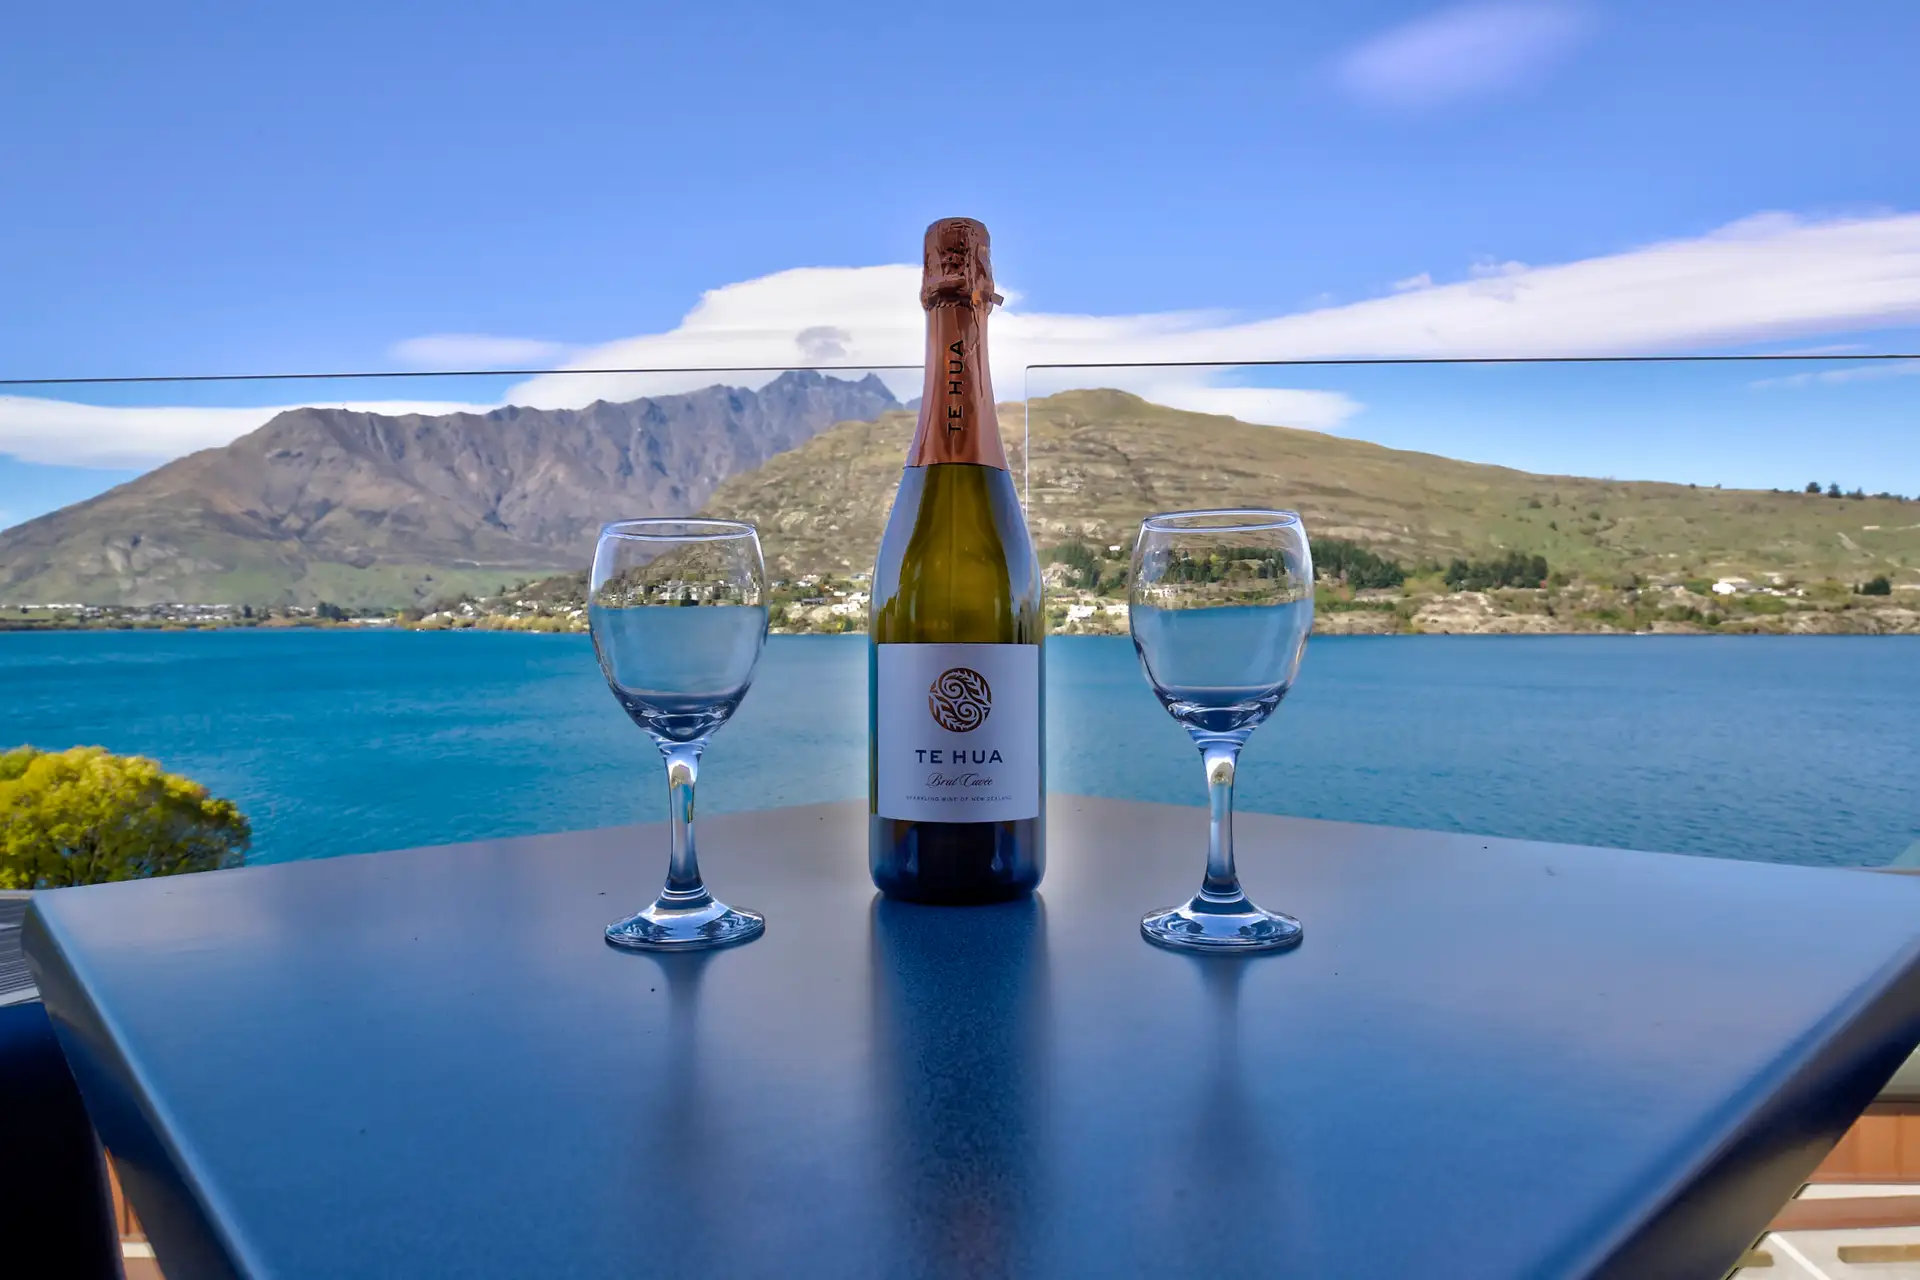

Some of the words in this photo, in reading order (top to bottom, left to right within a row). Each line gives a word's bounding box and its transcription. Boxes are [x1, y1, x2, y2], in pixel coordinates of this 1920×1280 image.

[949, 340, 964, 395] HUA
[948, 405, 962, 436] TE
[915, 749, 943, 764] TE
[952, 749, 1003, 764] HUA
[925, 772, 960, 788] Brut
